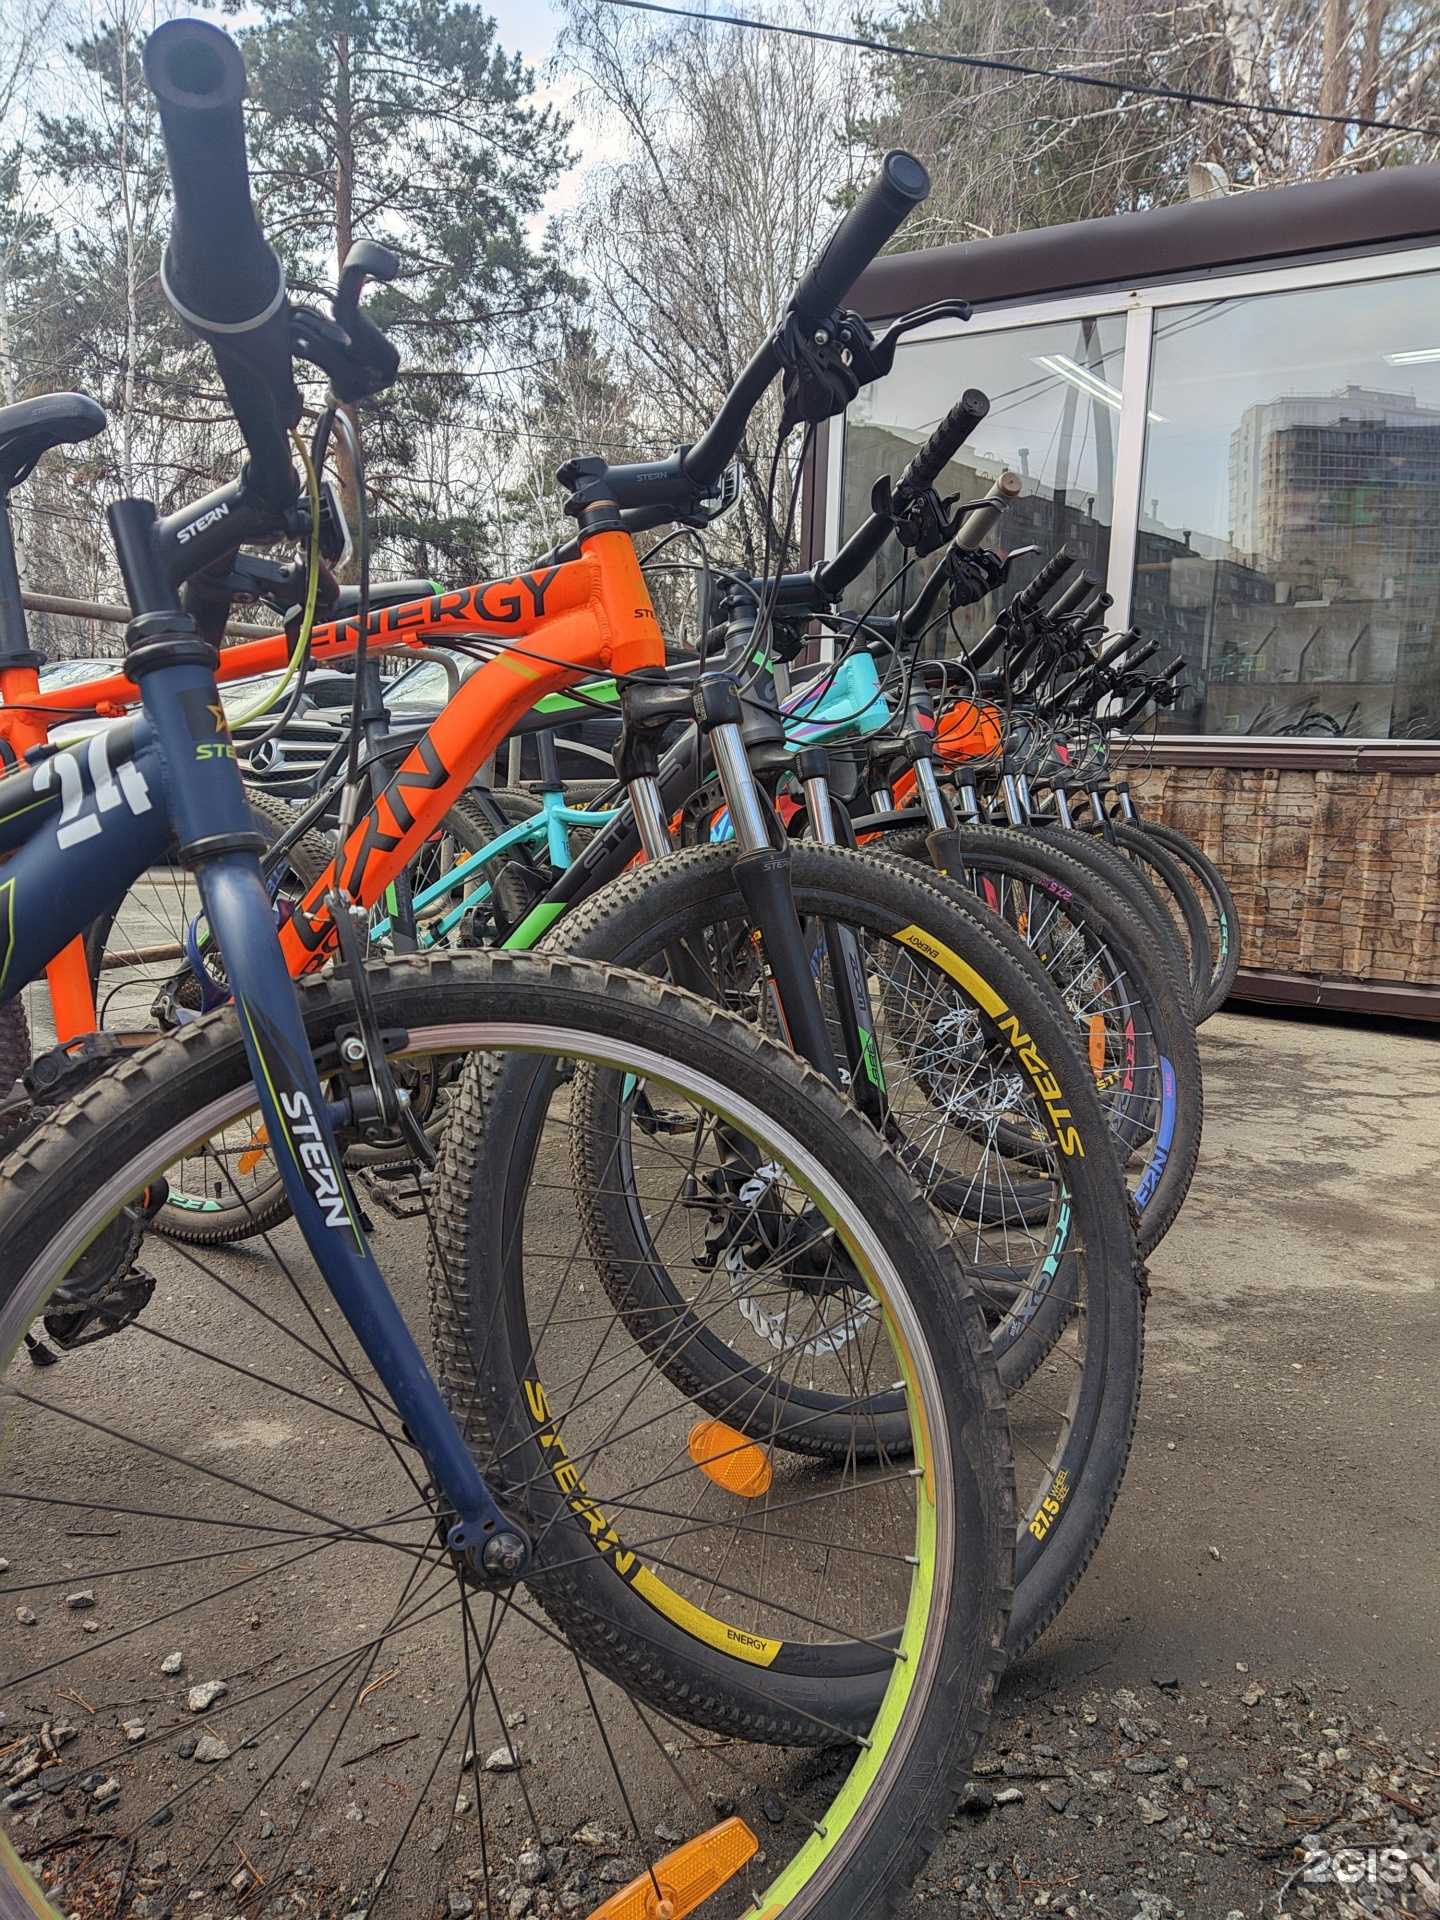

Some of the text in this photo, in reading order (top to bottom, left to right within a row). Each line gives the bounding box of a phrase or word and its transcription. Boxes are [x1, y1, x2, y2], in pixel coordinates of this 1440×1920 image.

[177, 503, 229, 544] STERN
[311, 566, 560, 647] ENERGY
[33, 730, 152, 850] 24
[584, 757, 683, 869] STES
[907, 935, 940, 959] ENERGY
[998, 1015, 1085, 1158] STERN
[280, 1091, 351, 1227] STERN
[524, 1380, 636, 1575] STERN
[1029, 1497, 1060, 1541] 27.5
[727, 1629, 767, 1651] ENERGY
